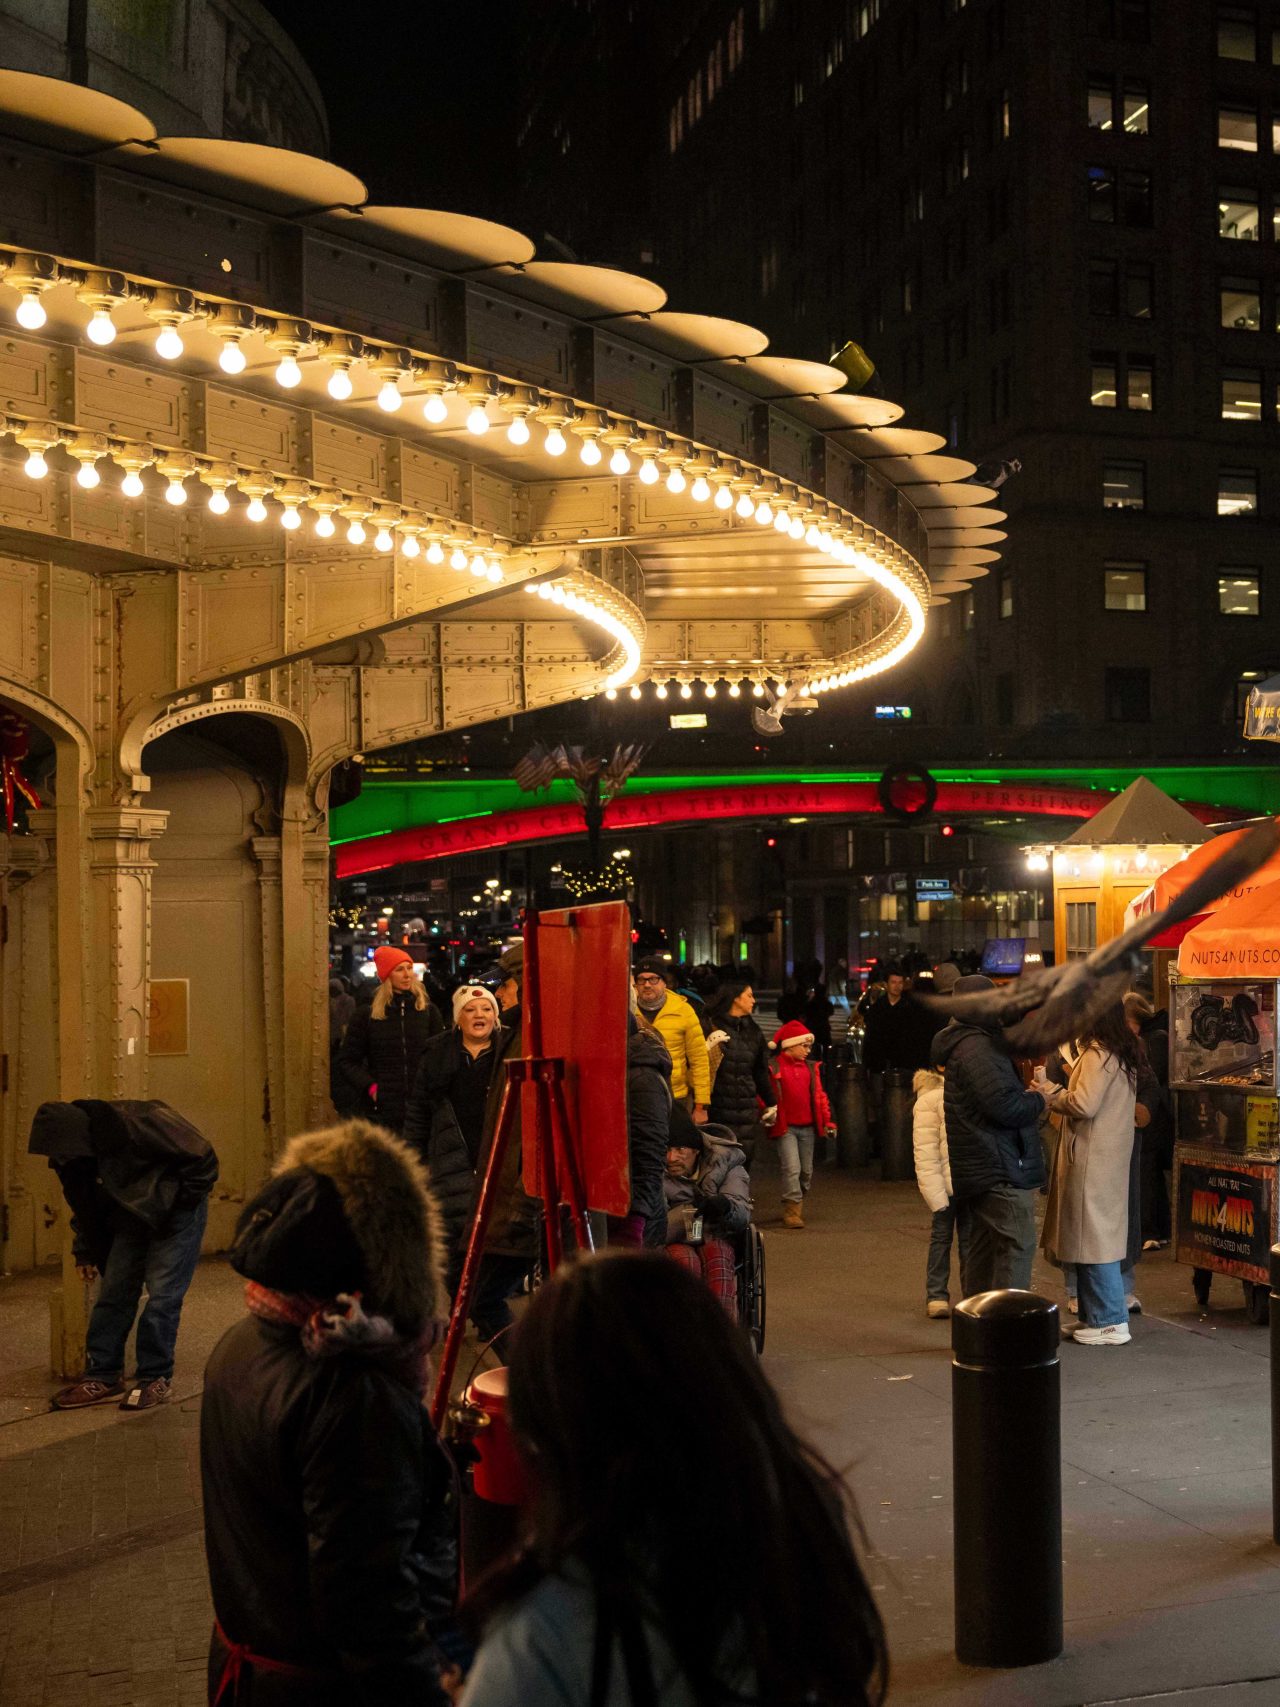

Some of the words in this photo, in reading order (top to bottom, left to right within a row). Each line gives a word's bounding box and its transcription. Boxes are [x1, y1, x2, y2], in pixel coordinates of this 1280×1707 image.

[419, 818, 520, 851] GRAND
[540, 800, 666, 830] CENRAL
[688, 791, 826, 812] TERMINAL
[970, 790, 1091, 811] PERSHING
[1218, 1177, 1240, 1191] NATRAL
